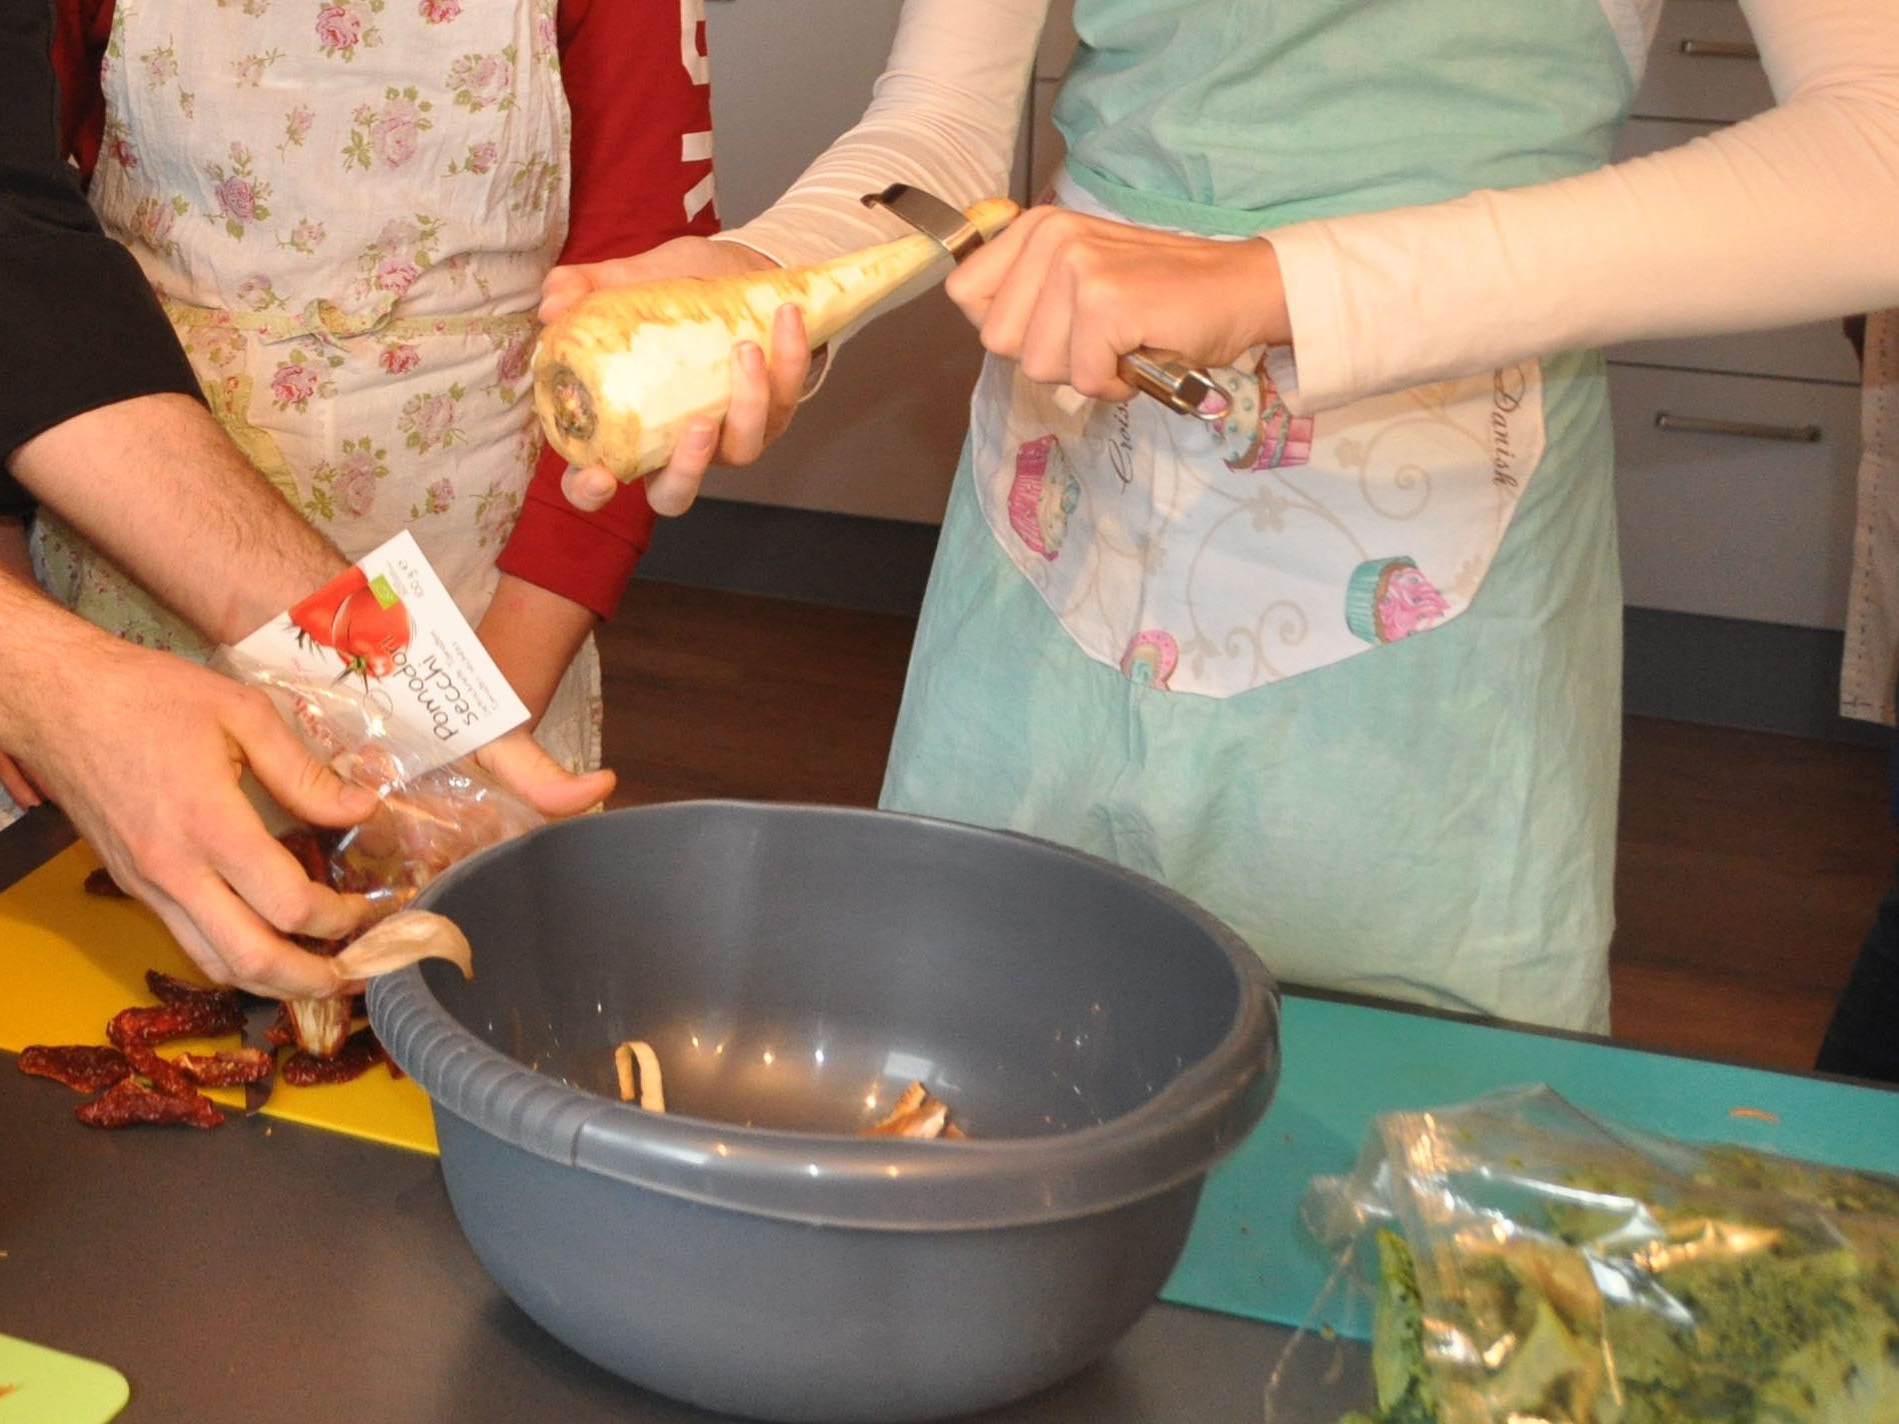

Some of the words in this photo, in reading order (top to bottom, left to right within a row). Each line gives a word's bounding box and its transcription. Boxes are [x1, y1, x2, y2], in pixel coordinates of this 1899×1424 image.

[1108, 399, 1134, 495] Crois
[1491, 363, 1526, 488] Danish
[381, 635, 459, 741] Pomodori
[418, 655, 479, 726] secchi
